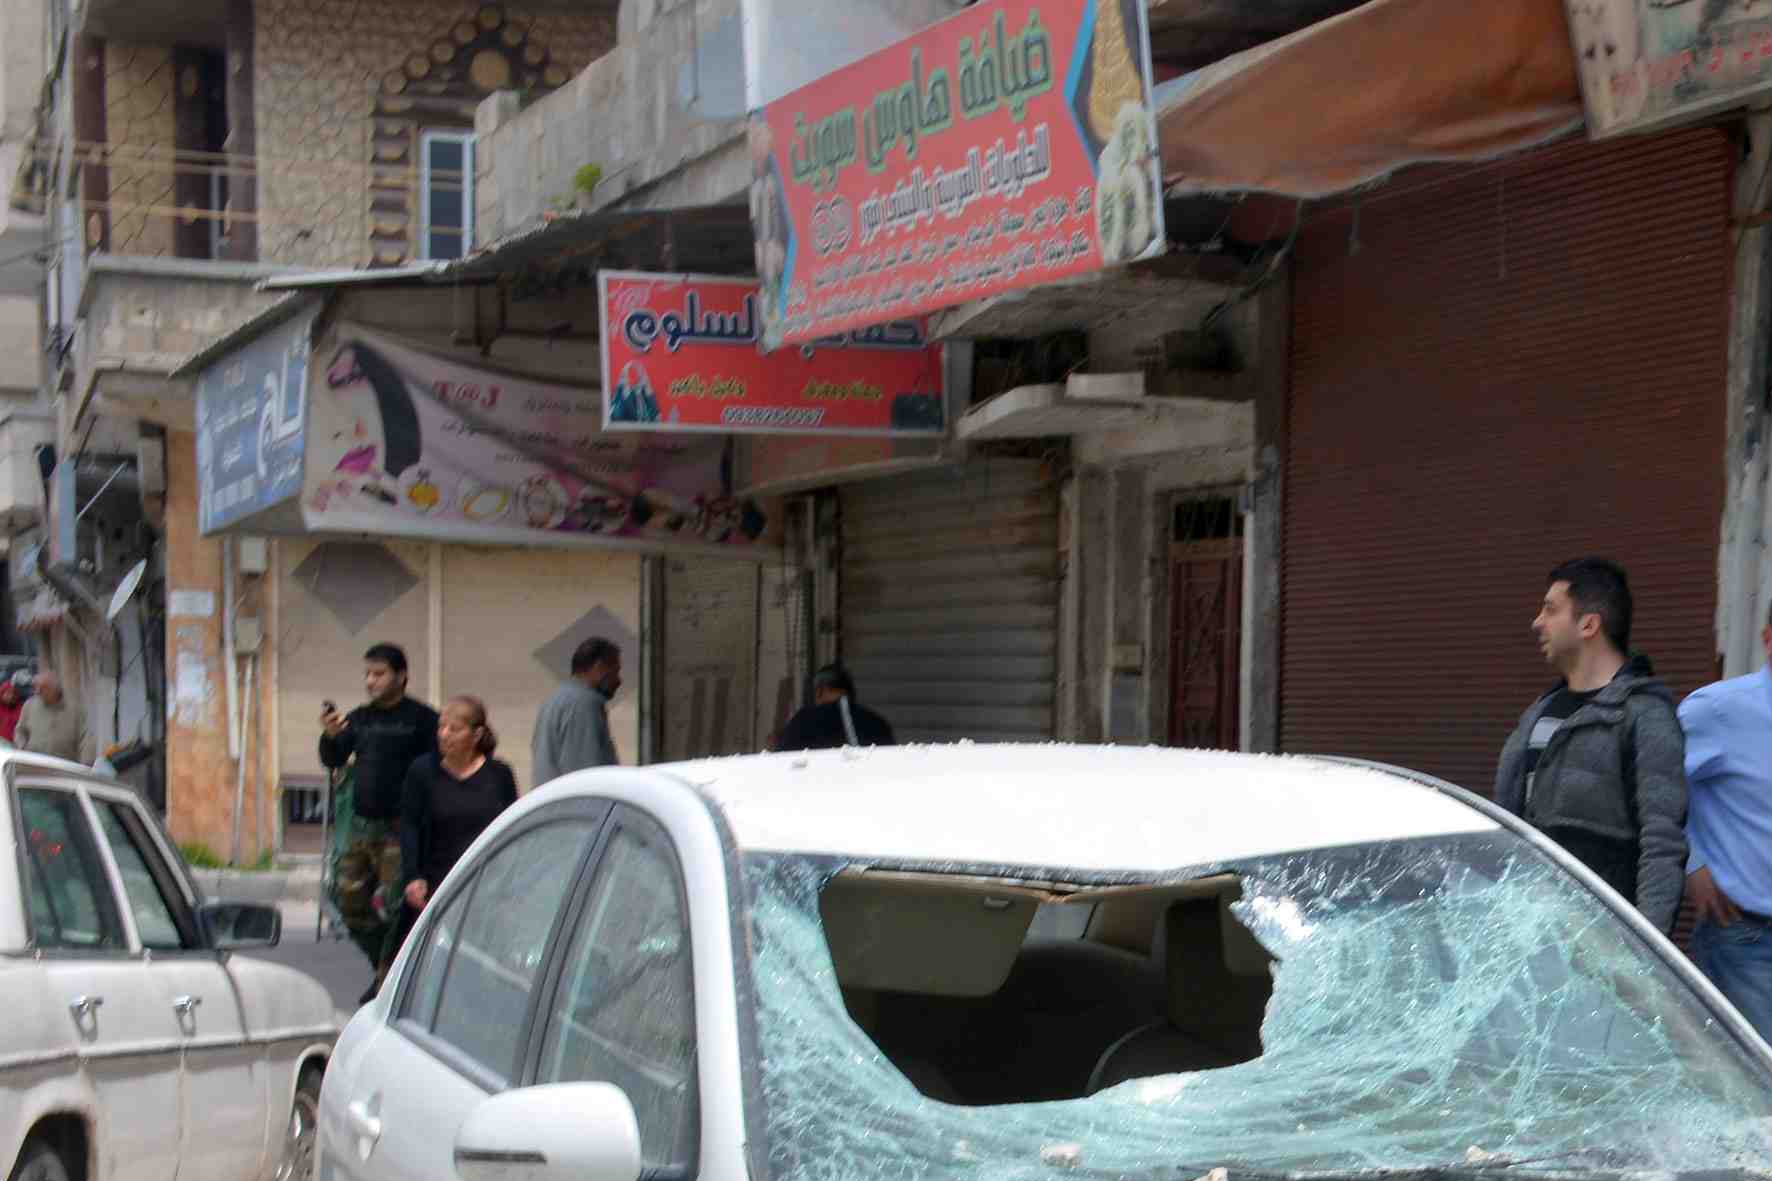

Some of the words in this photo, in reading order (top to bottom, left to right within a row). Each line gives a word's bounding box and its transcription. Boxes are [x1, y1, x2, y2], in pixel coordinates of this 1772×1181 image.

[863, 44, 951, 174] هاوس
[960, 9, 1053, 122] ضيافة
[789, 105, 856, 194] سويت
